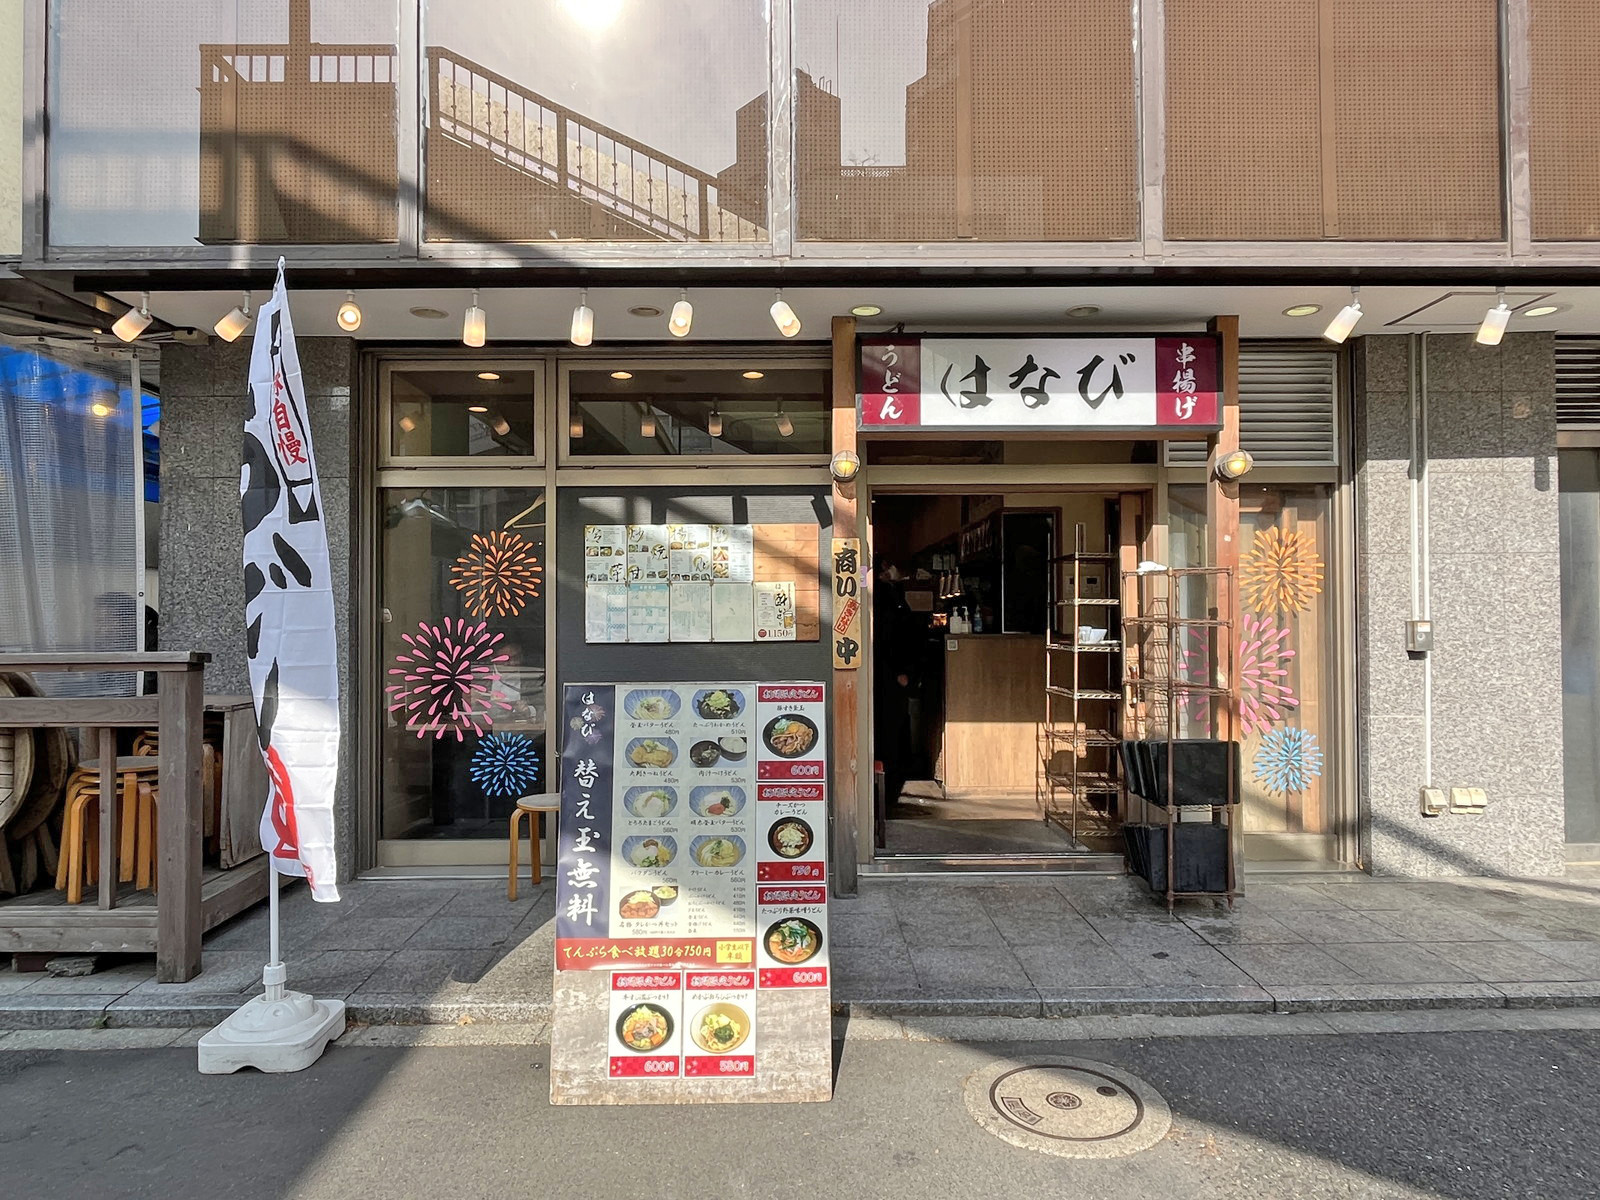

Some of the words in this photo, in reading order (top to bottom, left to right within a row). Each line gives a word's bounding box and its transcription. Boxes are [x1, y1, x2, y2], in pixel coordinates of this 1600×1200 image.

[880, 345, 903, 420] うどん
[940, 353, 1136, 409] はなび
[1172, 342, 1199, 420] 串揚げ
[581, 691, 596, 738] はなび
[790, 765, 820, 776] 600円
[566, 758, 601, 926] 替え玉無料
[792, 971, 823, 983] 600円
[643, 1060, 675, 1073] 600円
[719, 1060, 749, 1072] 580円
